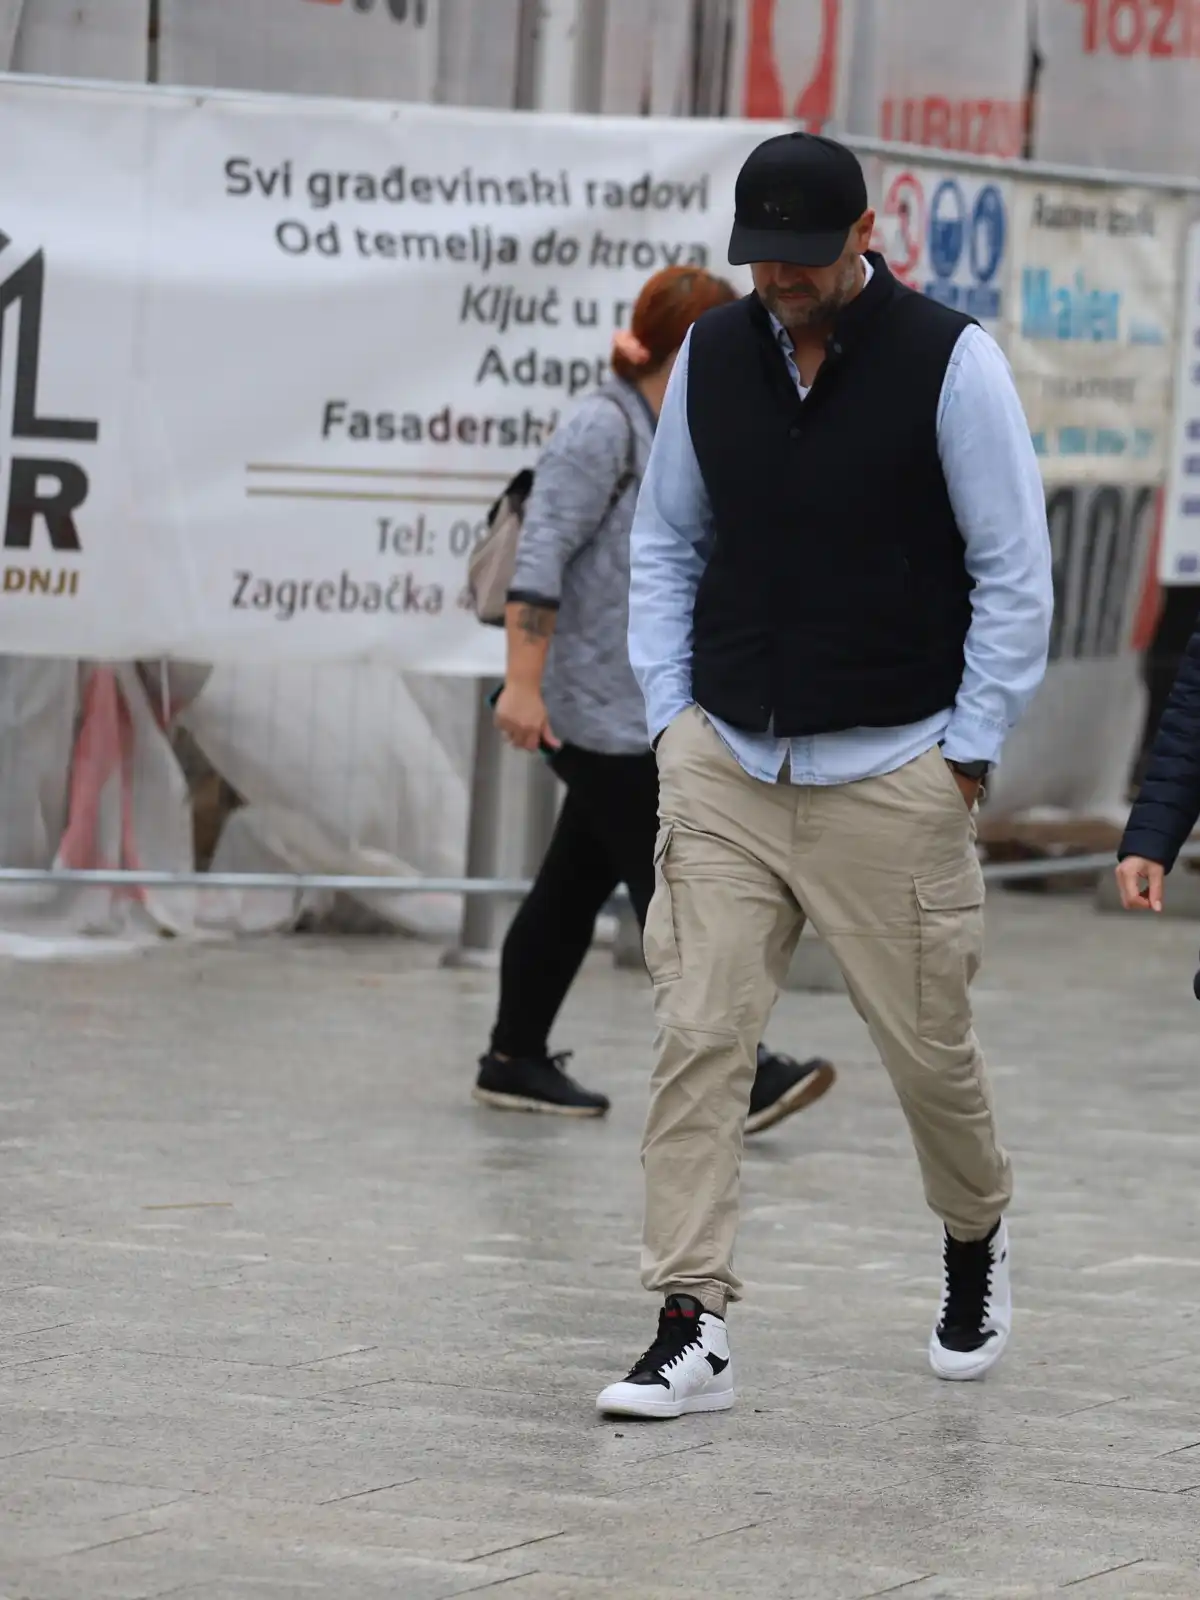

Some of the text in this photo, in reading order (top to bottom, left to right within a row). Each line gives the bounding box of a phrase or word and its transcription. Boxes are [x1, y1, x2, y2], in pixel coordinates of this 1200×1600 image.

[223, 156, 293, 198] Svi
[585, 172, 710, 212] radovi
[274, 218, 710, 275] Od temelja do krova
[460, 284, 560, 334] Ključ
[573, 298, 599, 328] u
[377, 514, 437, 557] Tel:
[231, 570, 444, 621] Zagrebačka
